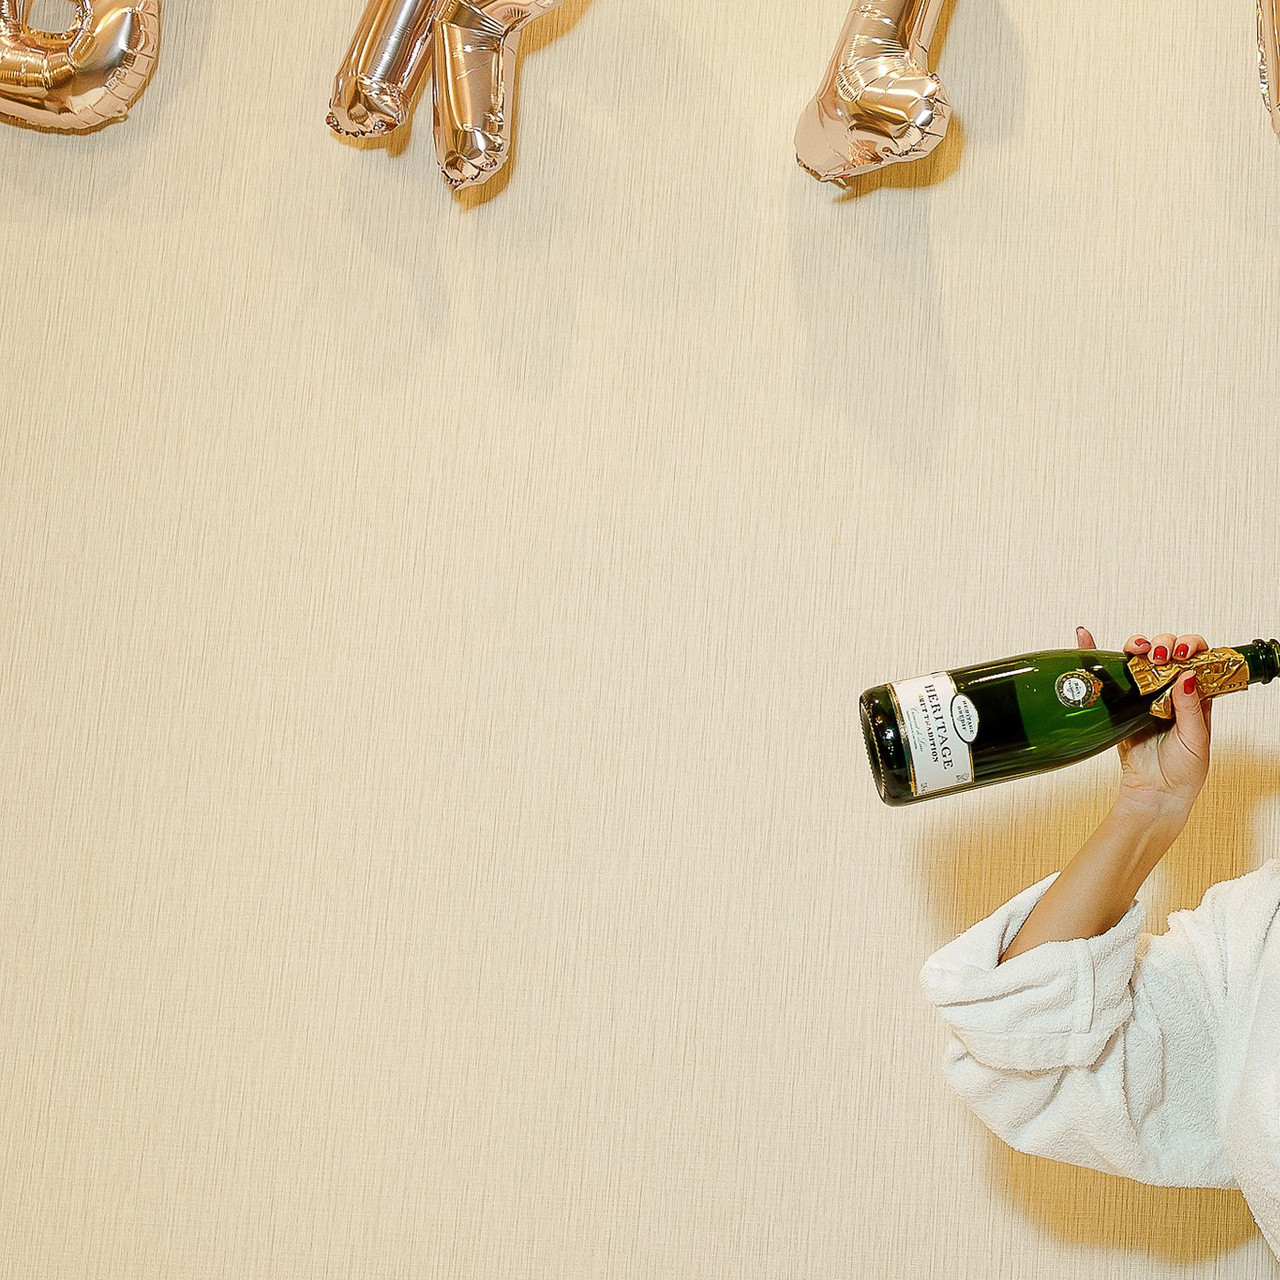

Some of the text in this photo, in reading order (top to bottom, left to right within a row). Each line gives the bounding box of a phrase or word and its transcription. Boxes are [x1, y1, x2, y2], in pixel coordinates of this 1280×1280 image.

[918, 693, 939, 763] BRUT TRADITION
[925, 684, 953, 770] HERITAGE
